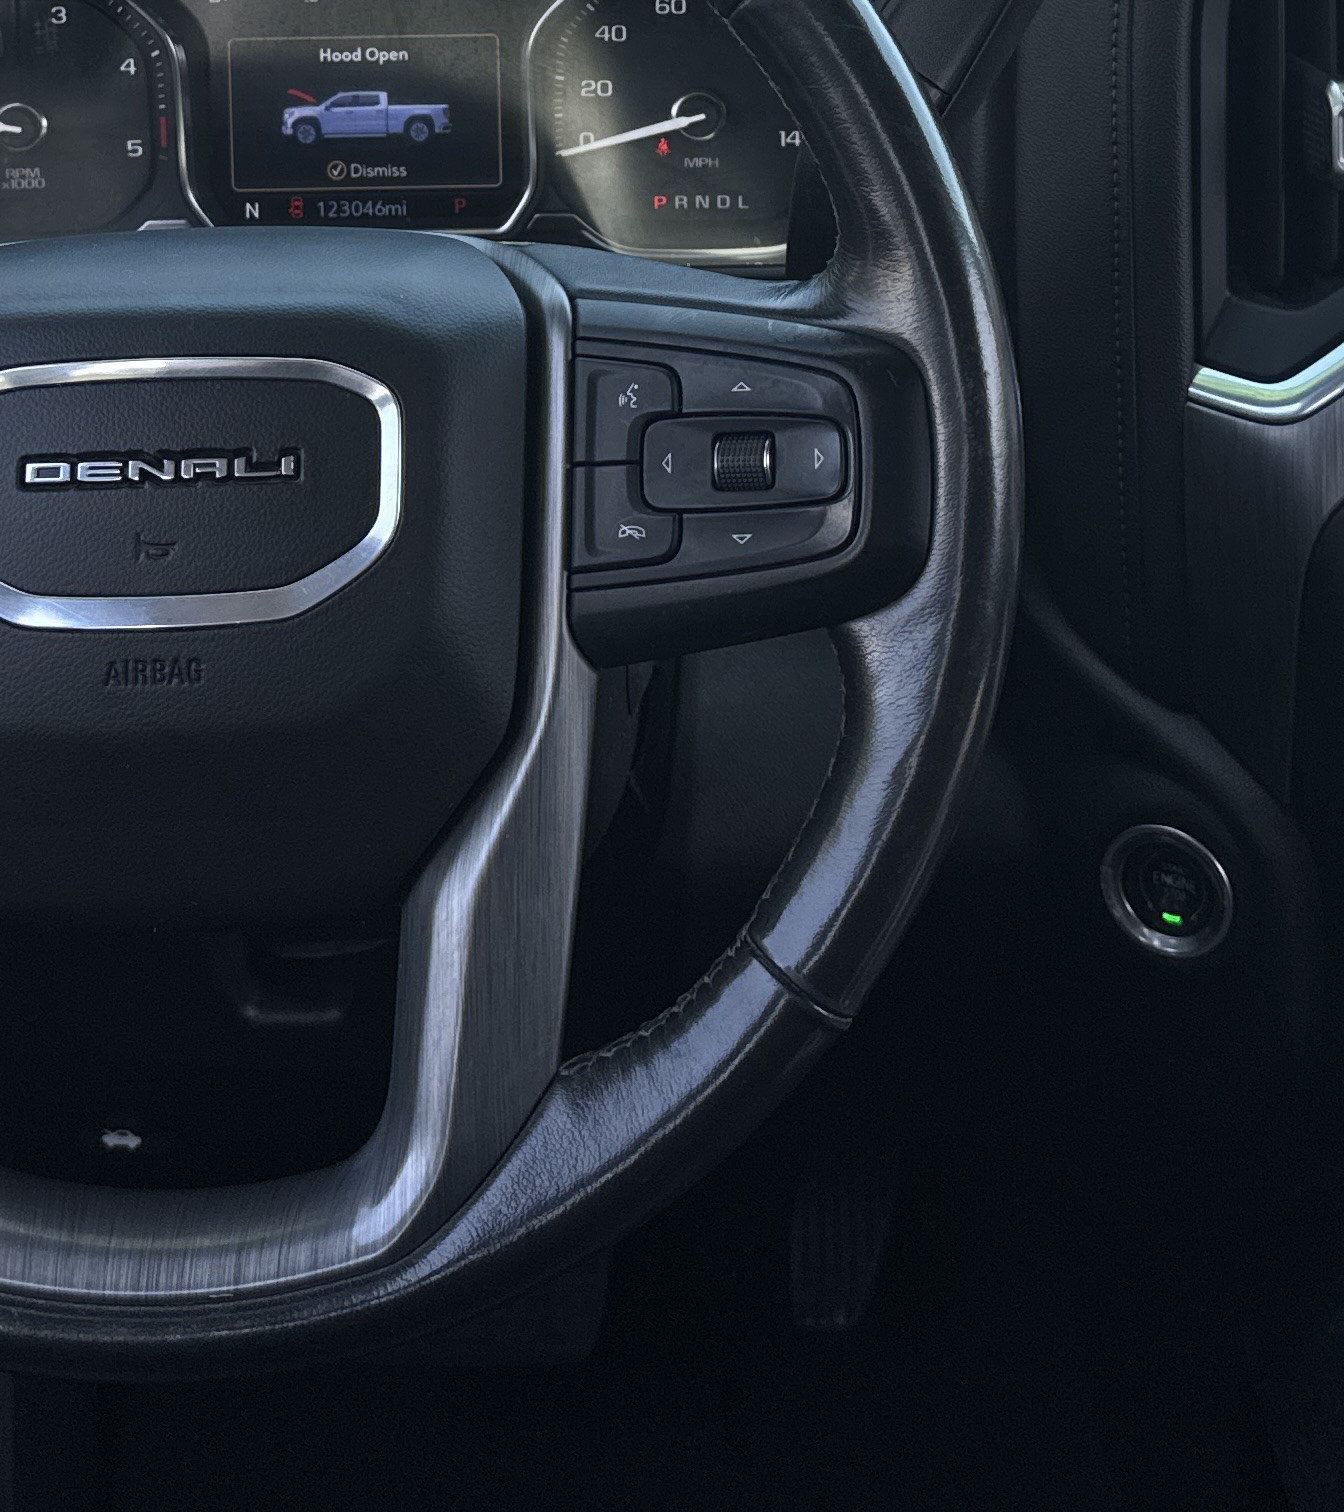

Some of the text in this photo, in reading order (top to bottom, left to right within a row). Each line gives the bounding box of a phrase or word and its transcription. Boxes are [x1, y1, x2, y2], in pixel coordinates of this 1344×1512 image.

[51, 6, 67, 25] 3
[594, 24, 627, 42] 40
[319, 47, 409, 65] Hood Open
[120, 58, 137, 75] 4
[580, 79, 613, 97] 20
[779, 129, 804, 147] 14
[126, 139, 143, 157] 5
[350, 163, 407, 178] Dismiss
[683, 157, 719, 168] MPH
[5, 167, 41, 179] RPM
[1, 177, 46, 189] x1000
[245, 201, 259, 220] N
[454, 198, 467, 214] P
[24, 454, 296, 484] DENALI
[105, 656, 206, 688] AIRBAG
